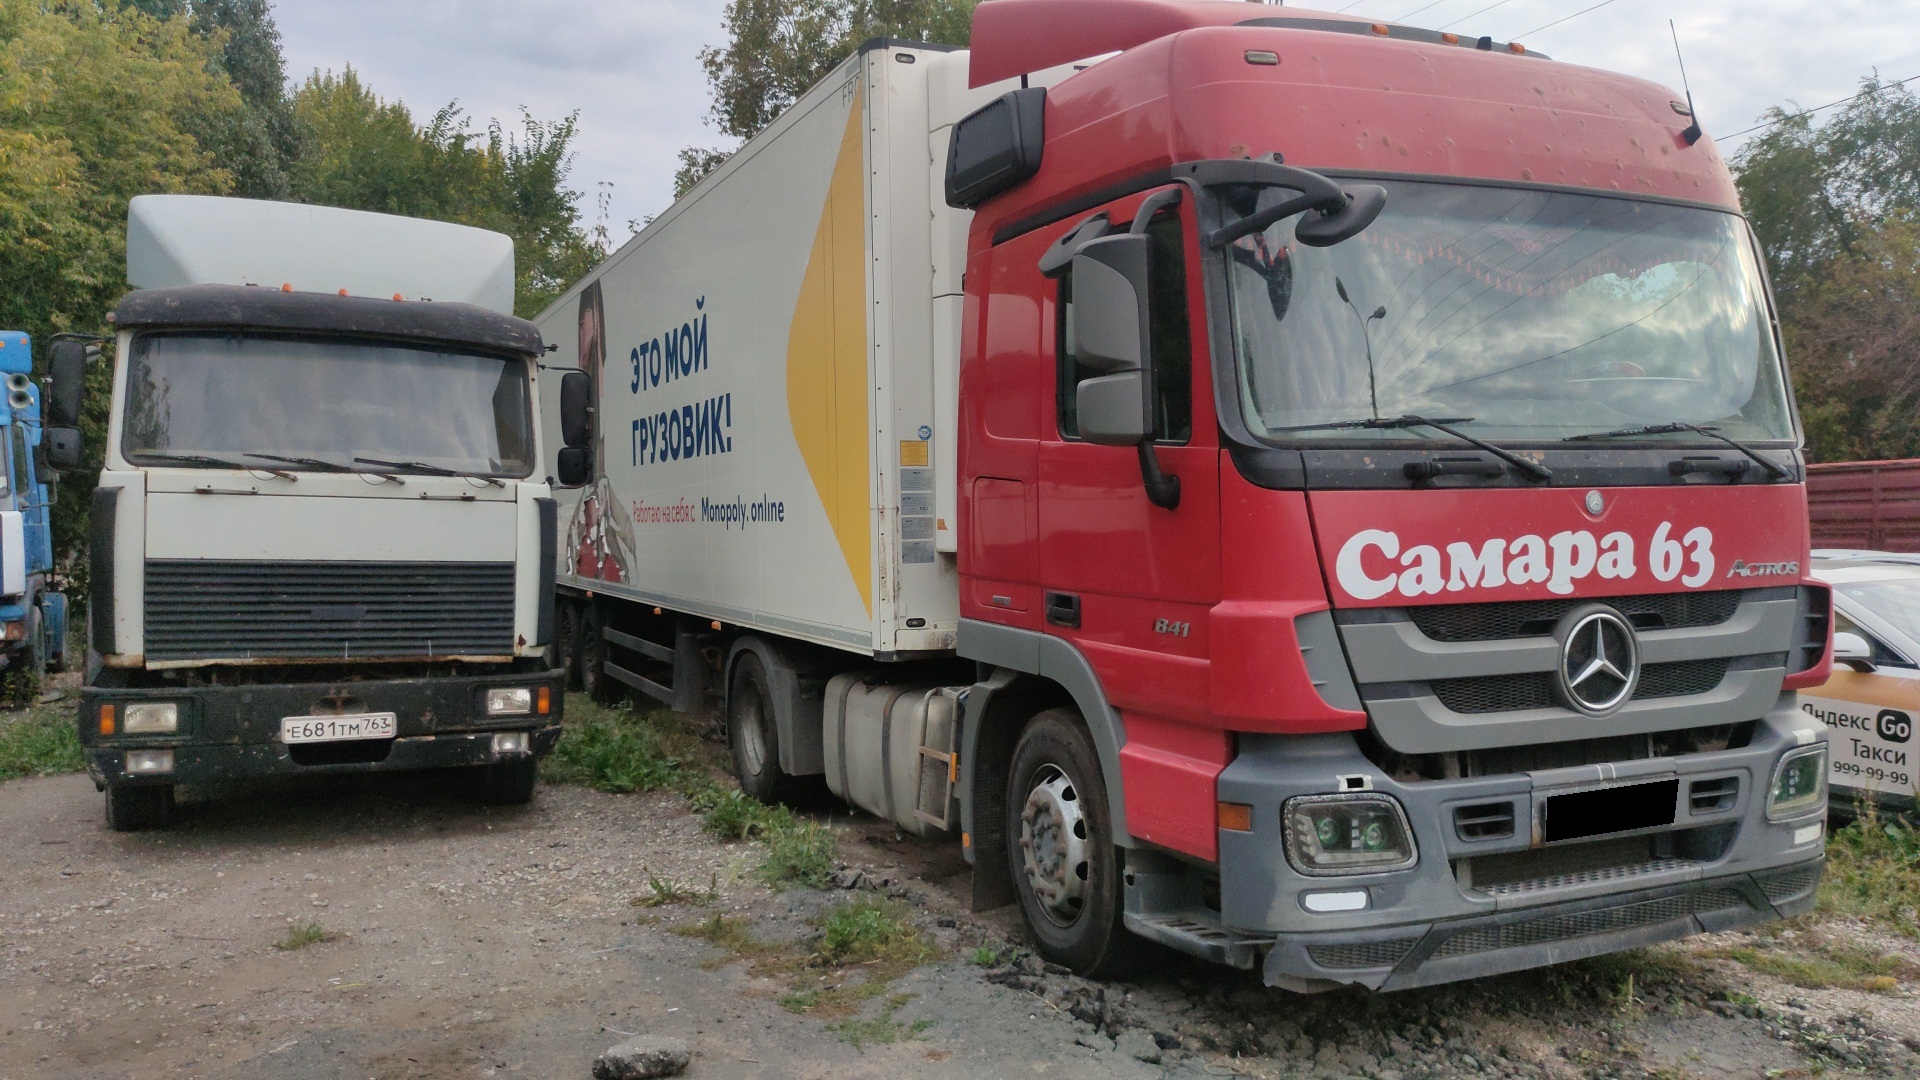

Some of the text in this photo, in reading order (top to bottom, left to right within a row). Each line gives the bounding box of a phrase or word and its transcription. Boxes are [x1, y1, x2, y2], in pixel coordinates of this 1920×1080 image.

[630, 295, 708, 395] ЭТО МОЙ
[632, 392, 732, 467] ГРУЗОВИК!
[633, 500, 661, 523] Работаю
[662, 506, 671, 522] на
[671, 496, 690, 523] себя
[1335, 521, 1716, 600] Самара 63
[1154, 618, 1190, 638] 841
[363, 717, 389, 730] 763
[1880, 715, 1910, 738] Go
[1850, 738, 1906, 766] Такси
[1833, 761, 1909, 785] 999-99-99
